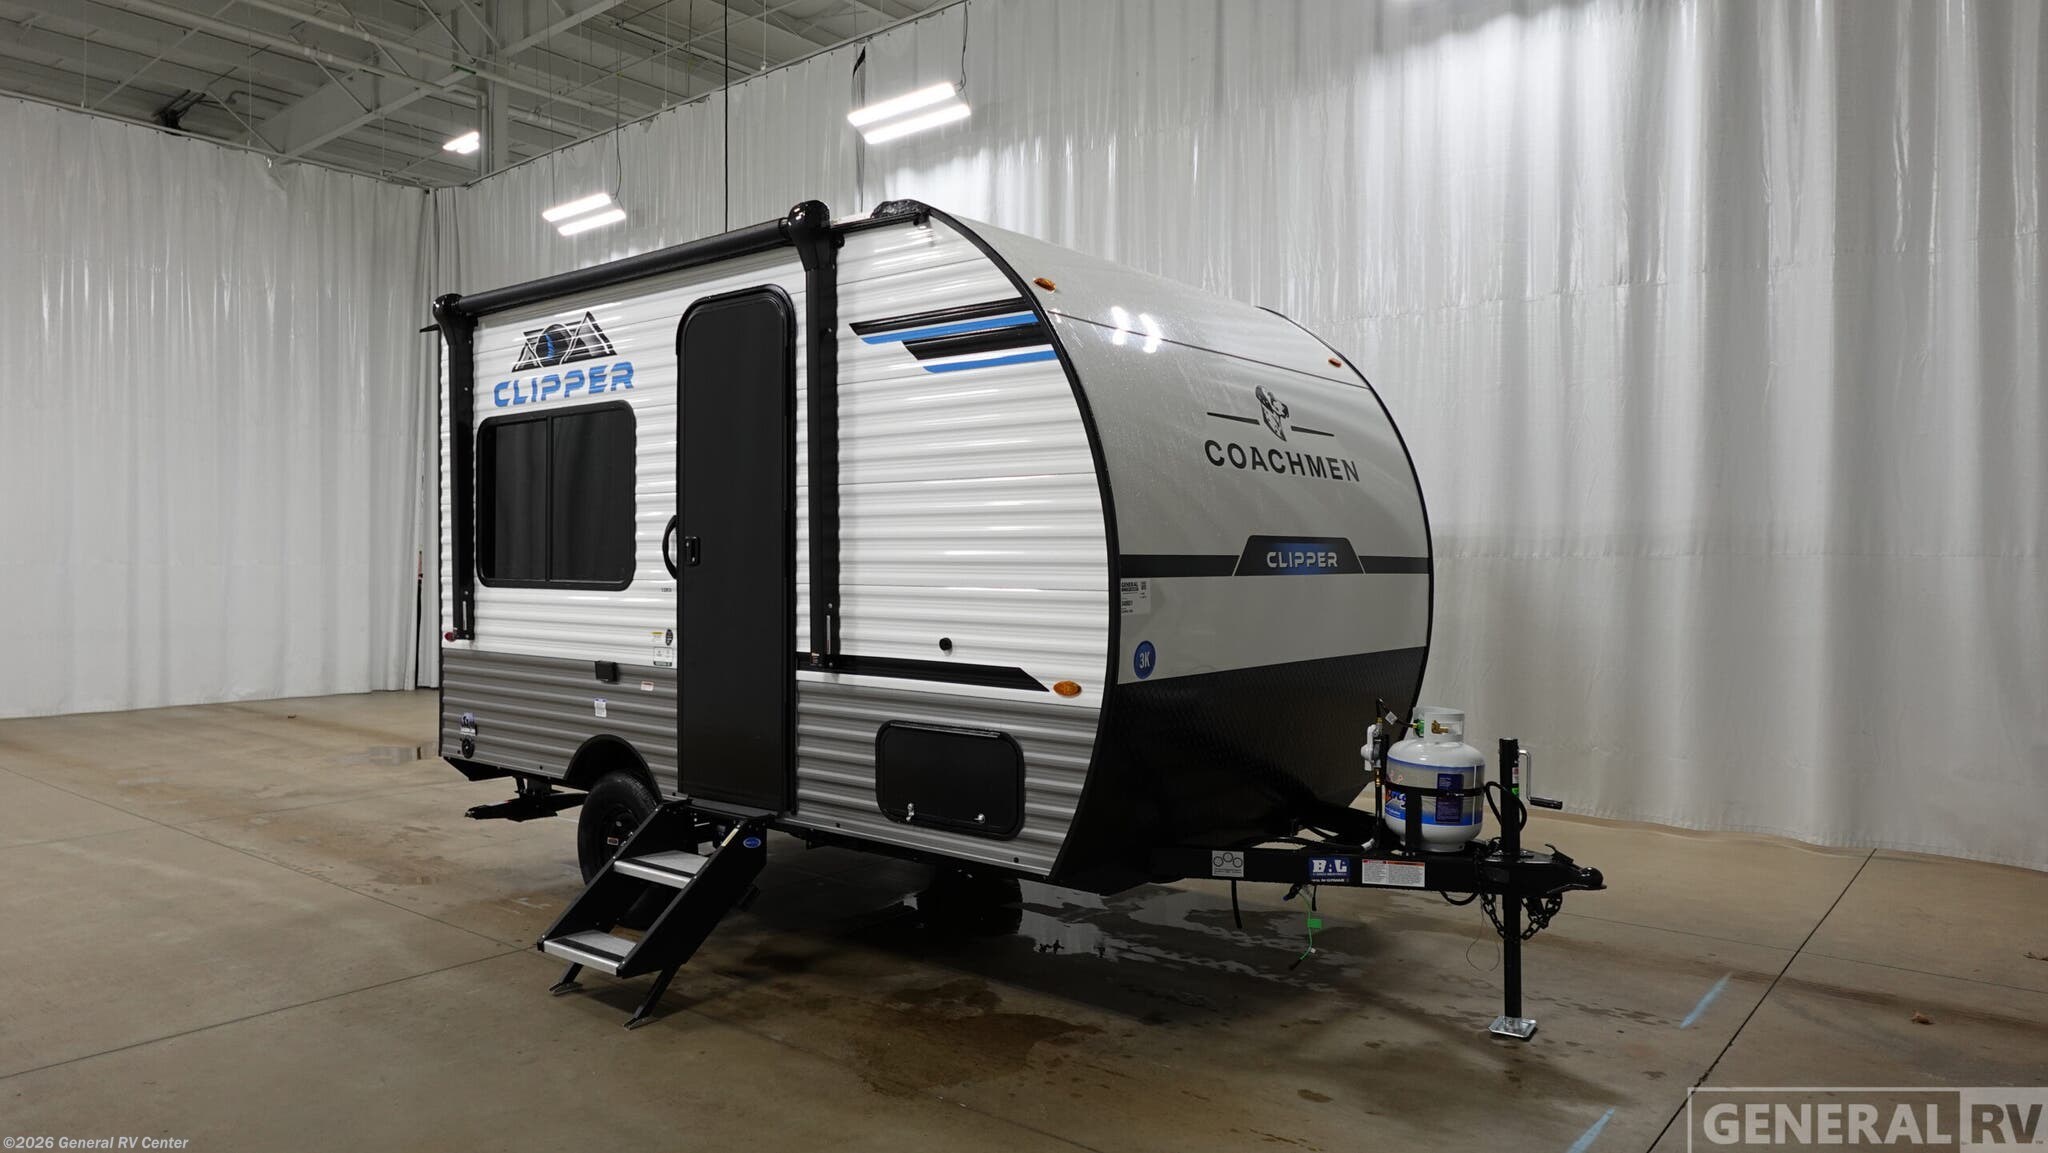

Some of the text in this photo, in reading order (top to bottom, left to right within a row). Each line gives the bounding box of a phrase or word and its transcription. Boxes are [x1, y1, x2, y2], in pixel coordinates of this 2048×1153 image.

[494, 361, 634, 408] CLIPPER
[1204, 439, 1360, 483] COACHMEN
[1266, 551, 1338, 568] CLIPPER
[1139, 651, 1150, 669] 3K
